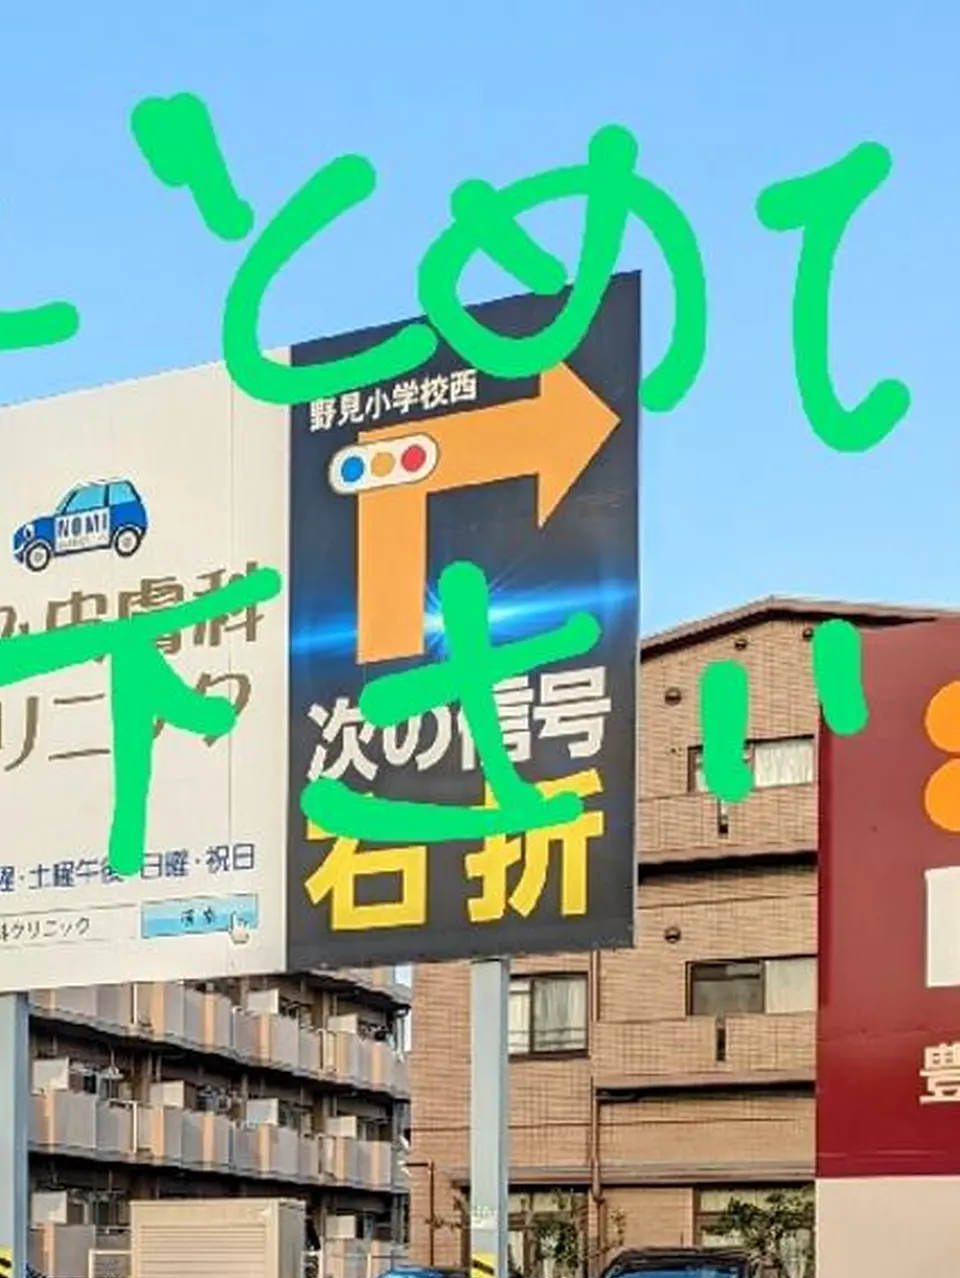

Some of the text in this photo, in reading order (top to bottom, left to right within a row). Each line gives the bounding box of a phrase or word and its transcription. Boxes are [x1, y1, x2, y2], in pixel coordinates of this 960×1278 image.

[308, 368, 479, 432] 野見小学校西
[58, 511, 108, 540] NOMI
